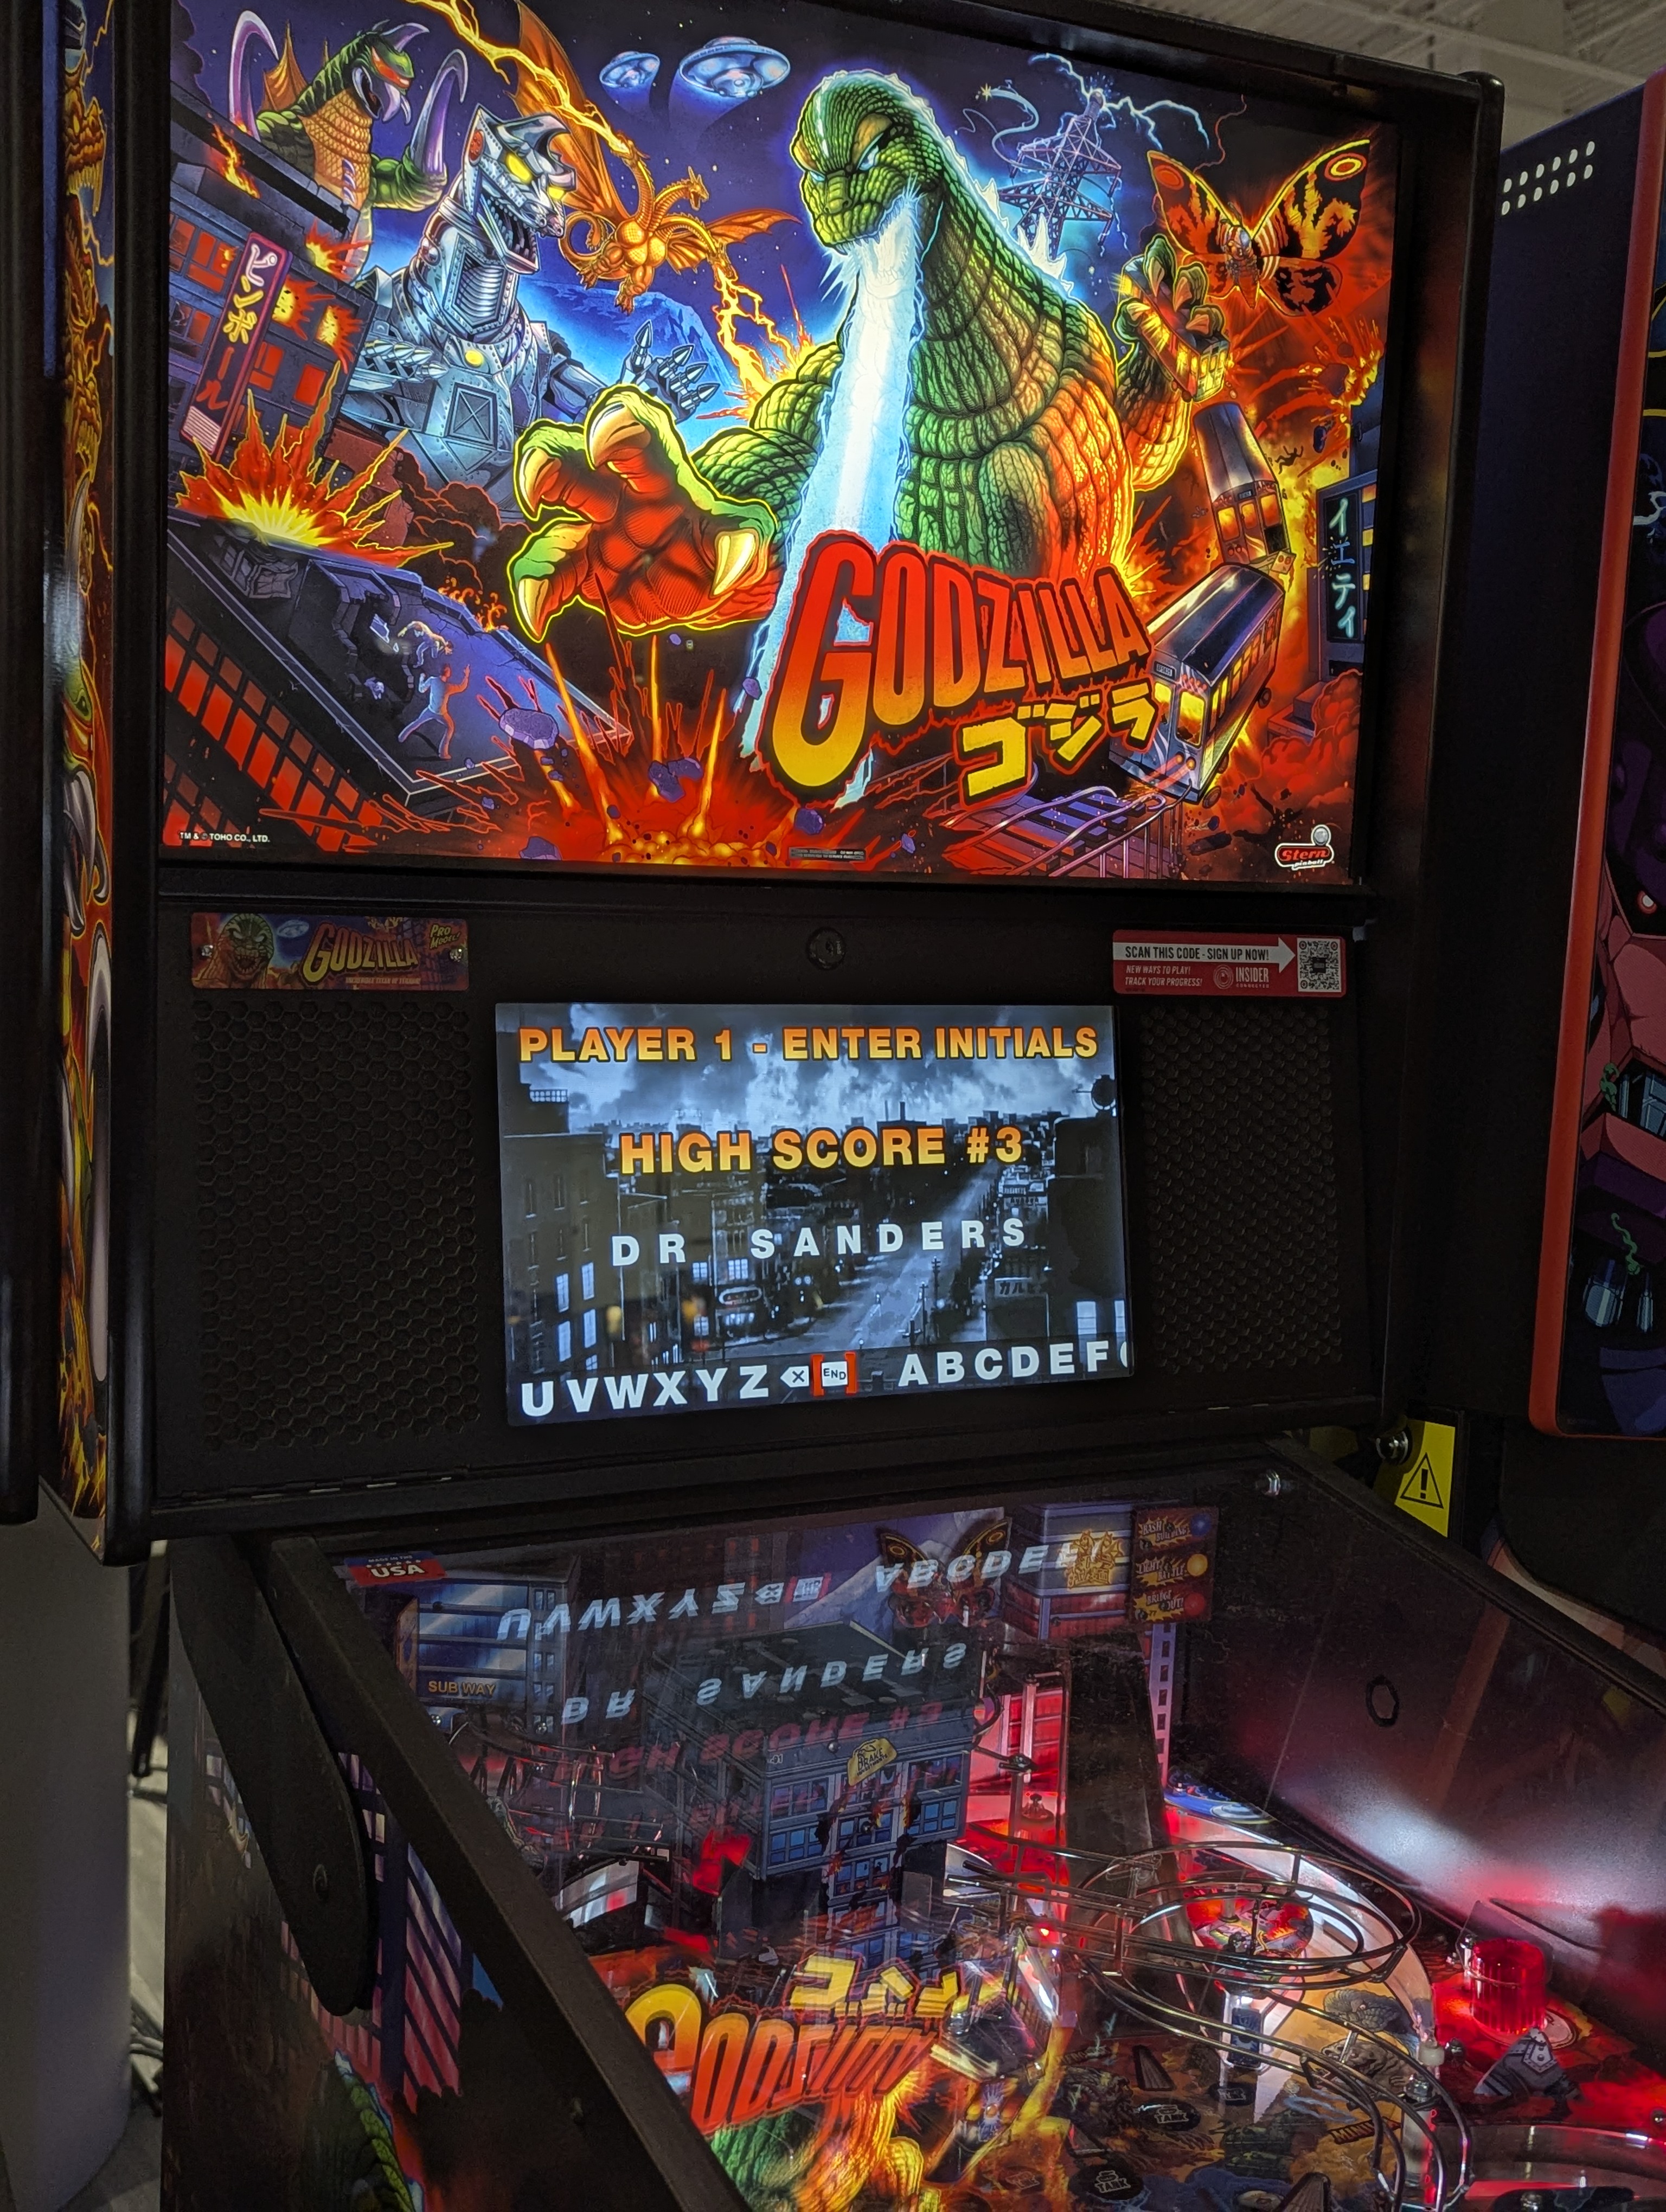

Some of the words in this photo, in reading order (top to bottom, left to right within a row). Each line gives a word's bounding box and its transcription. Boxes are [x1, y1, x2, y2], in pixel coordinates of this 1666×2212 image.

[195, 242, 278, 410] ピンボール
[1329, 498, 1356, 638] イエティ
[772, 541, 1150, 787] GODZILLA
[963, 683, 1155, 796] ゴジラ
[252, 834, 271, 843] LTD.
[1282, 849, 1329, 861] Stern
[1293, 859, 1324, 869] pinball
[430, 924, 451, 937] PRO
[303, 922, 419, 982] GODZILLA
[1125, 946, 1150, 958] SCAN
[1153, 947, 1174, 959] THIS
[1176, 947, 1200, 960] CODE
[1207, 948, 1228, 960] SIGN
[1231, 948, 1242, 960] UP
[1245, 949, 1269, 961] NOW!
[1126, 965, 1142, 974] NEW
[1143, 965, 1161, 974] WAYS
[1162, 966, 1171, 975] TO
[1172, 966, 1191, 975] PLAY!
[1236, 967, 1269, 982] INSIDER
[1125, 976, 1146, 986] TRACK
[1148, 977, 1165, 986] YOUR
[1167, 978, 1203, 987] PROGRESS!
[519, 1028, 697, 1063] PLAYER
[714, 1028, 732, 1061] 1
[753, 1043, 767, 1053] -
[783, 1027, 923, 1060] ENTER
[934, 1027, 1099, 1060] INITIALS
[620, 1131, 753, 1174] HIGH
[772, 1127, 945, 1171] SCORE
[966, 1125, 1023, 1164] #3
[750, 1218, 1024, 1258] SANDERS
[823, 1367, 847, 1381] END
[371, 1564, 425, 1578] USA
[1154, 2113, 1189, 2124] TANK
[1094, 2177, 1131, 2193] TANK
